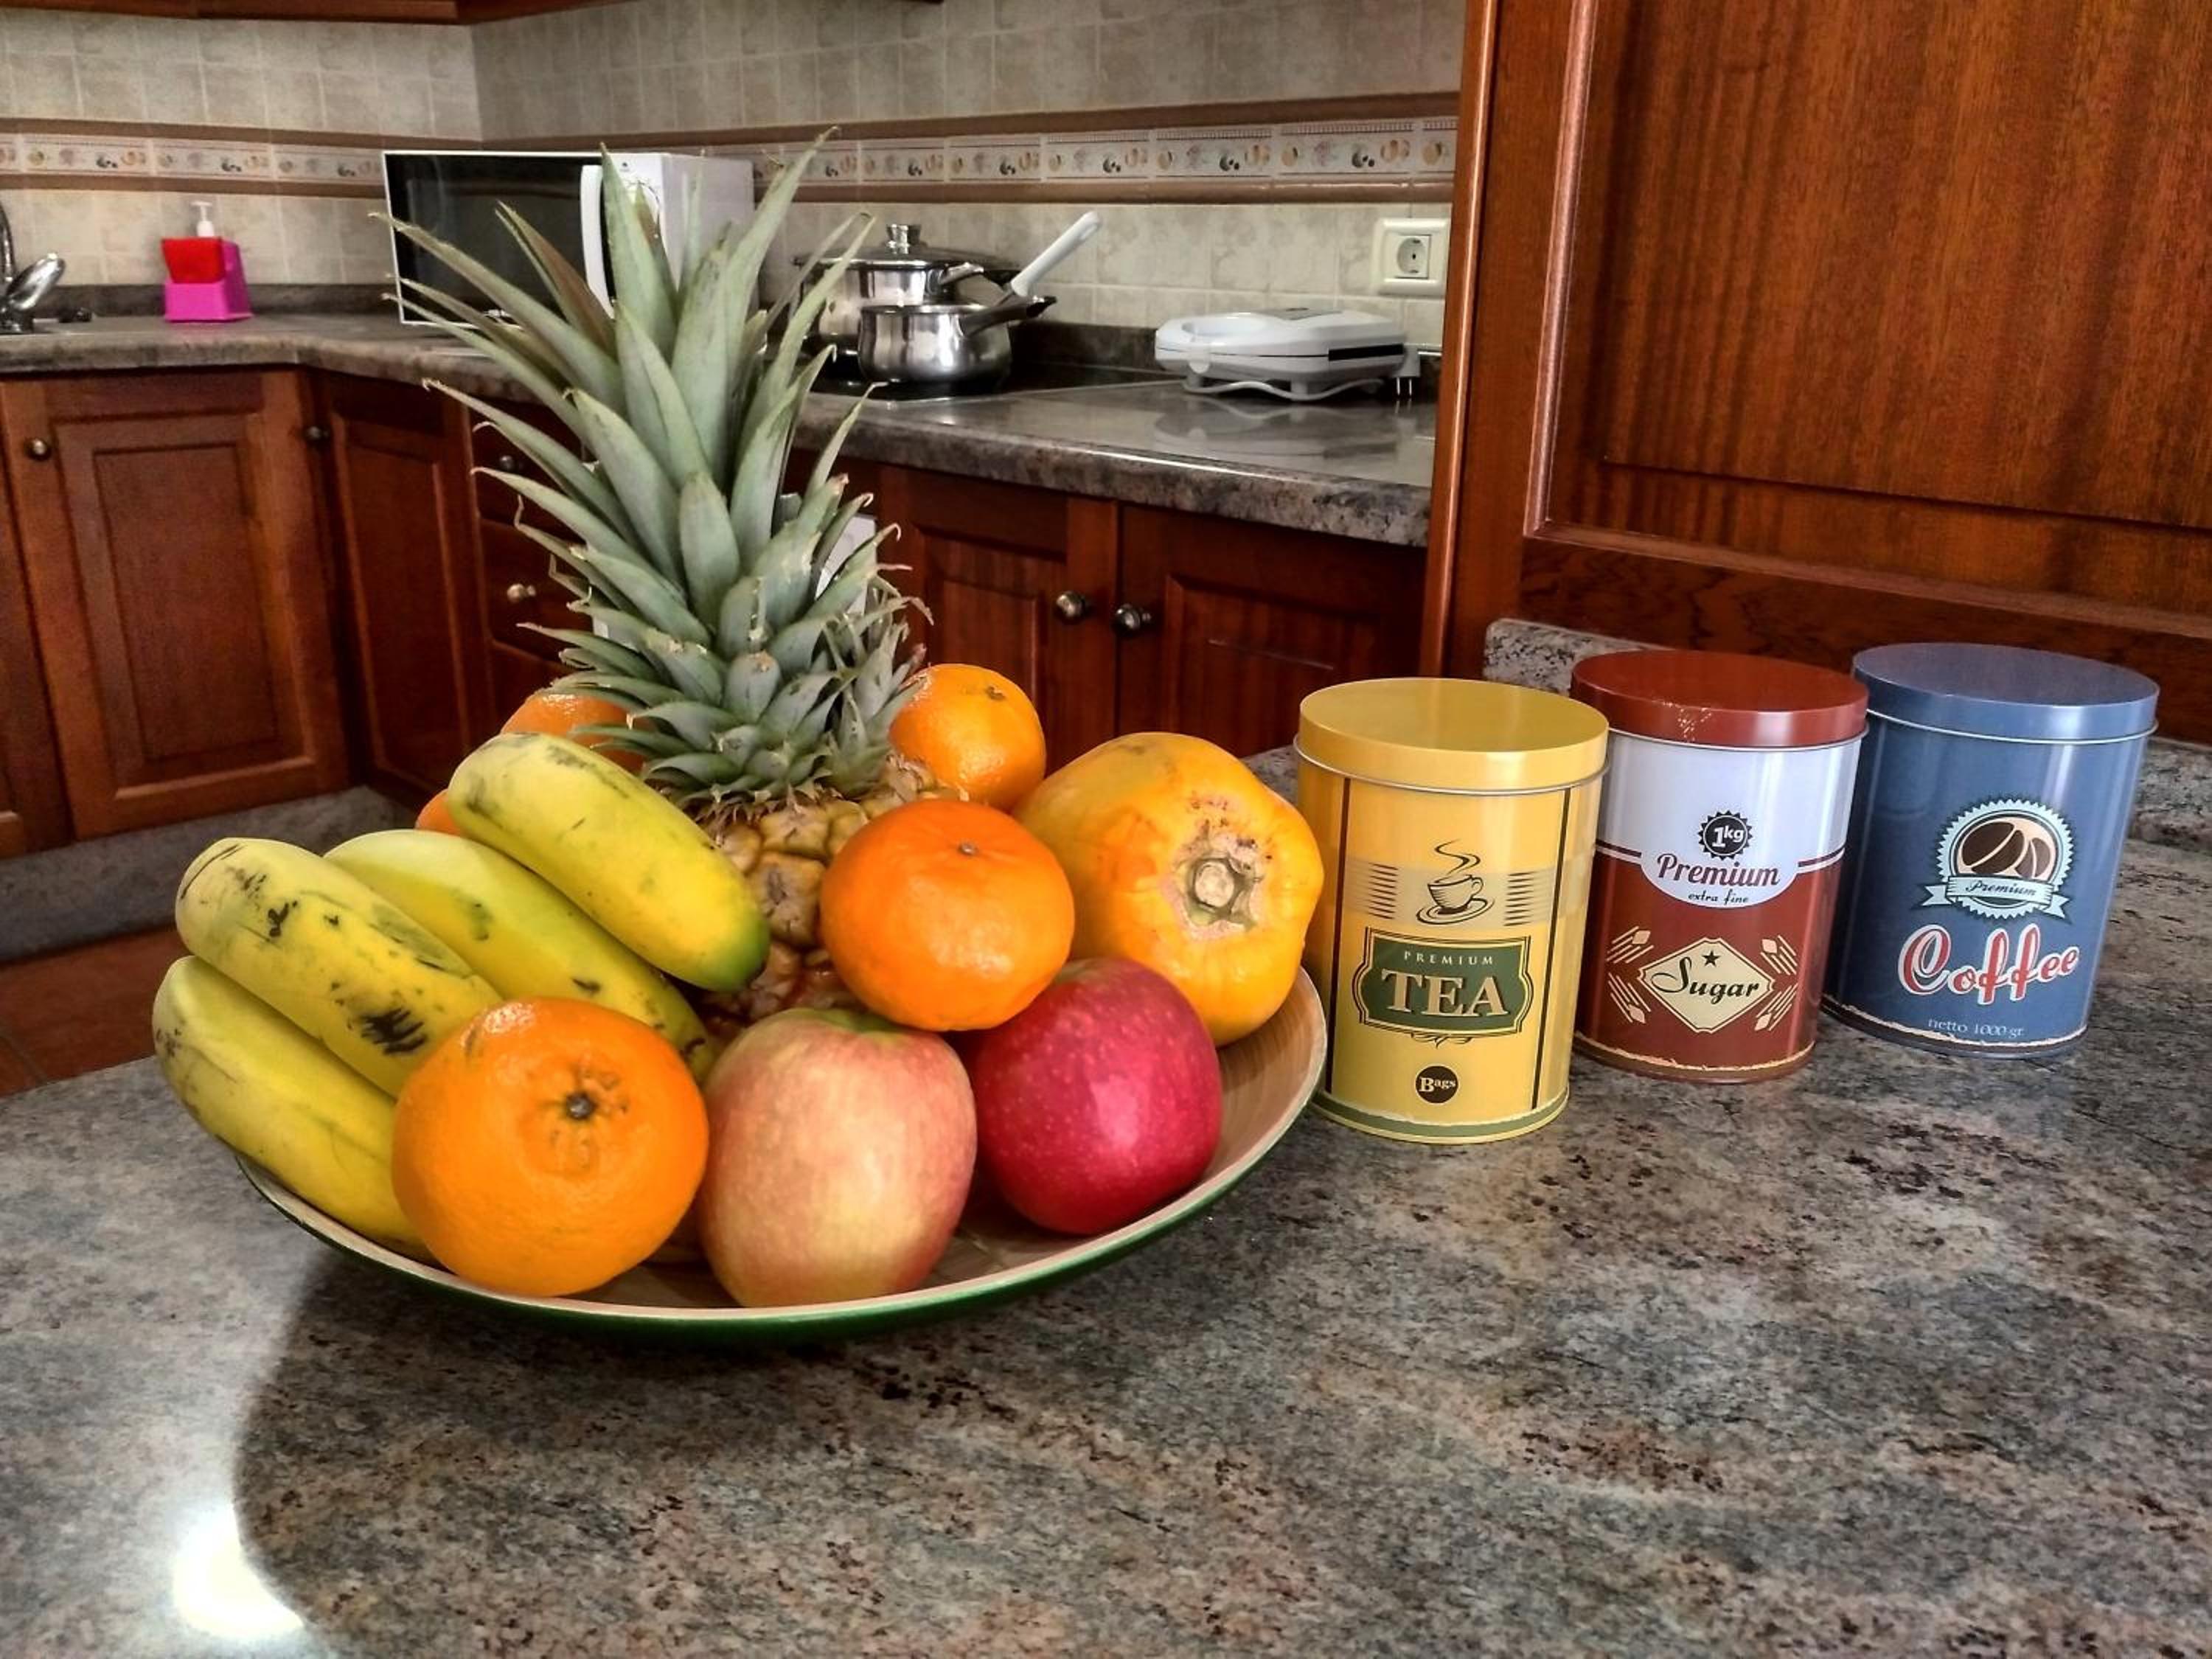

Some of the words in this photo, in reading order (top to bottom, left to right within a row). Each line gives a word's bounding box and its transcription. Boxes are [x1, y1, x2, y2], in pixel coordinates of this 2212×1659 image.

[1711, 825, 1745, 848] 1kg
[1656, 853, 1781, 887] Premium
[1688, 890, 1719, 902] extra
[1723, 888, 1749, 905] fine
[1965, 880, 2037, 896] Premium
[1404, 950, 1495, 965] PREMIUM
[1898, 923, 2080, 1005] Coffee
[1650, 956, 1760, 1004] Sugar
[1381, 968, 1509, 1018] TEA
[1927, 1018, 1968, 1033] netto
[1418, 1077, 1457, 1093] Bags
